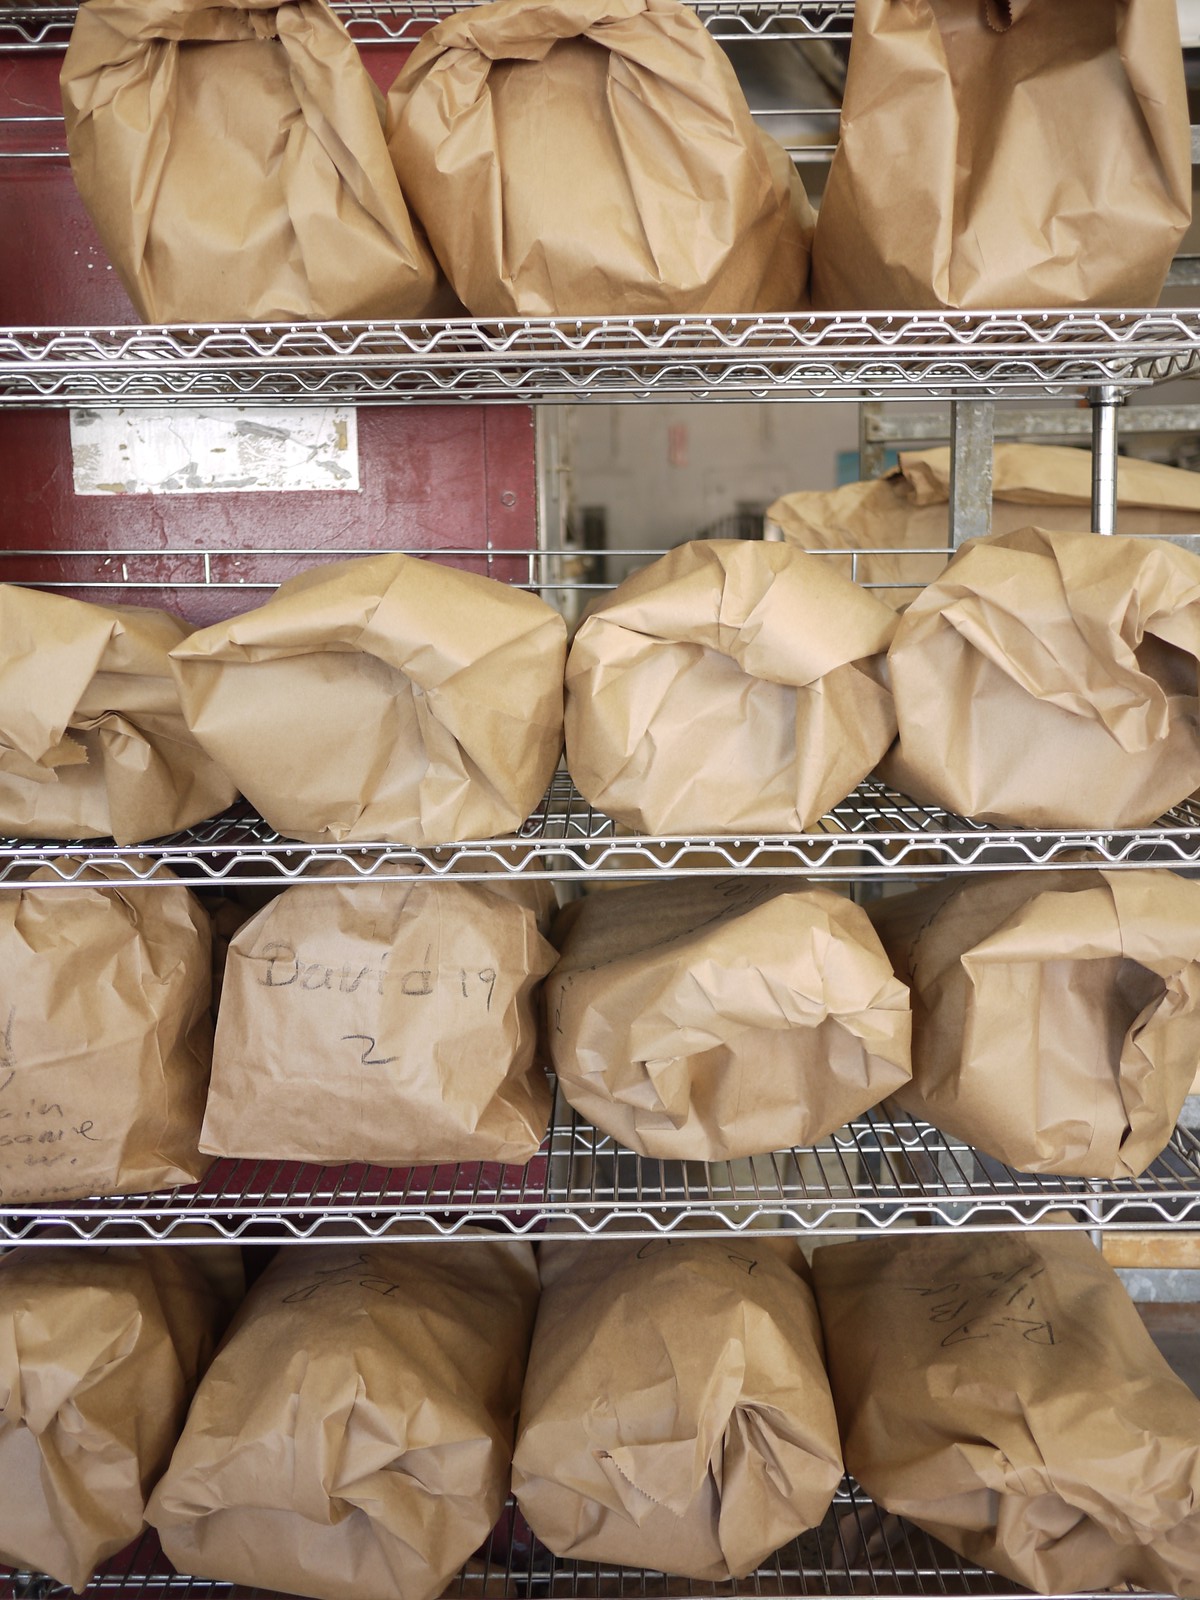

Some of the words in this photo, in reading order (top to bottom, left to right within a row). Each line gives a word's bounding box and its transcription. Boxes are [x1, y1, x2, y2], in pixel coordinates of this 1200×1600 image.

[257, 942, 433, 996] David
[457, 967, 497, 1012] 19
[340, 1034, 401, 1065] 2
